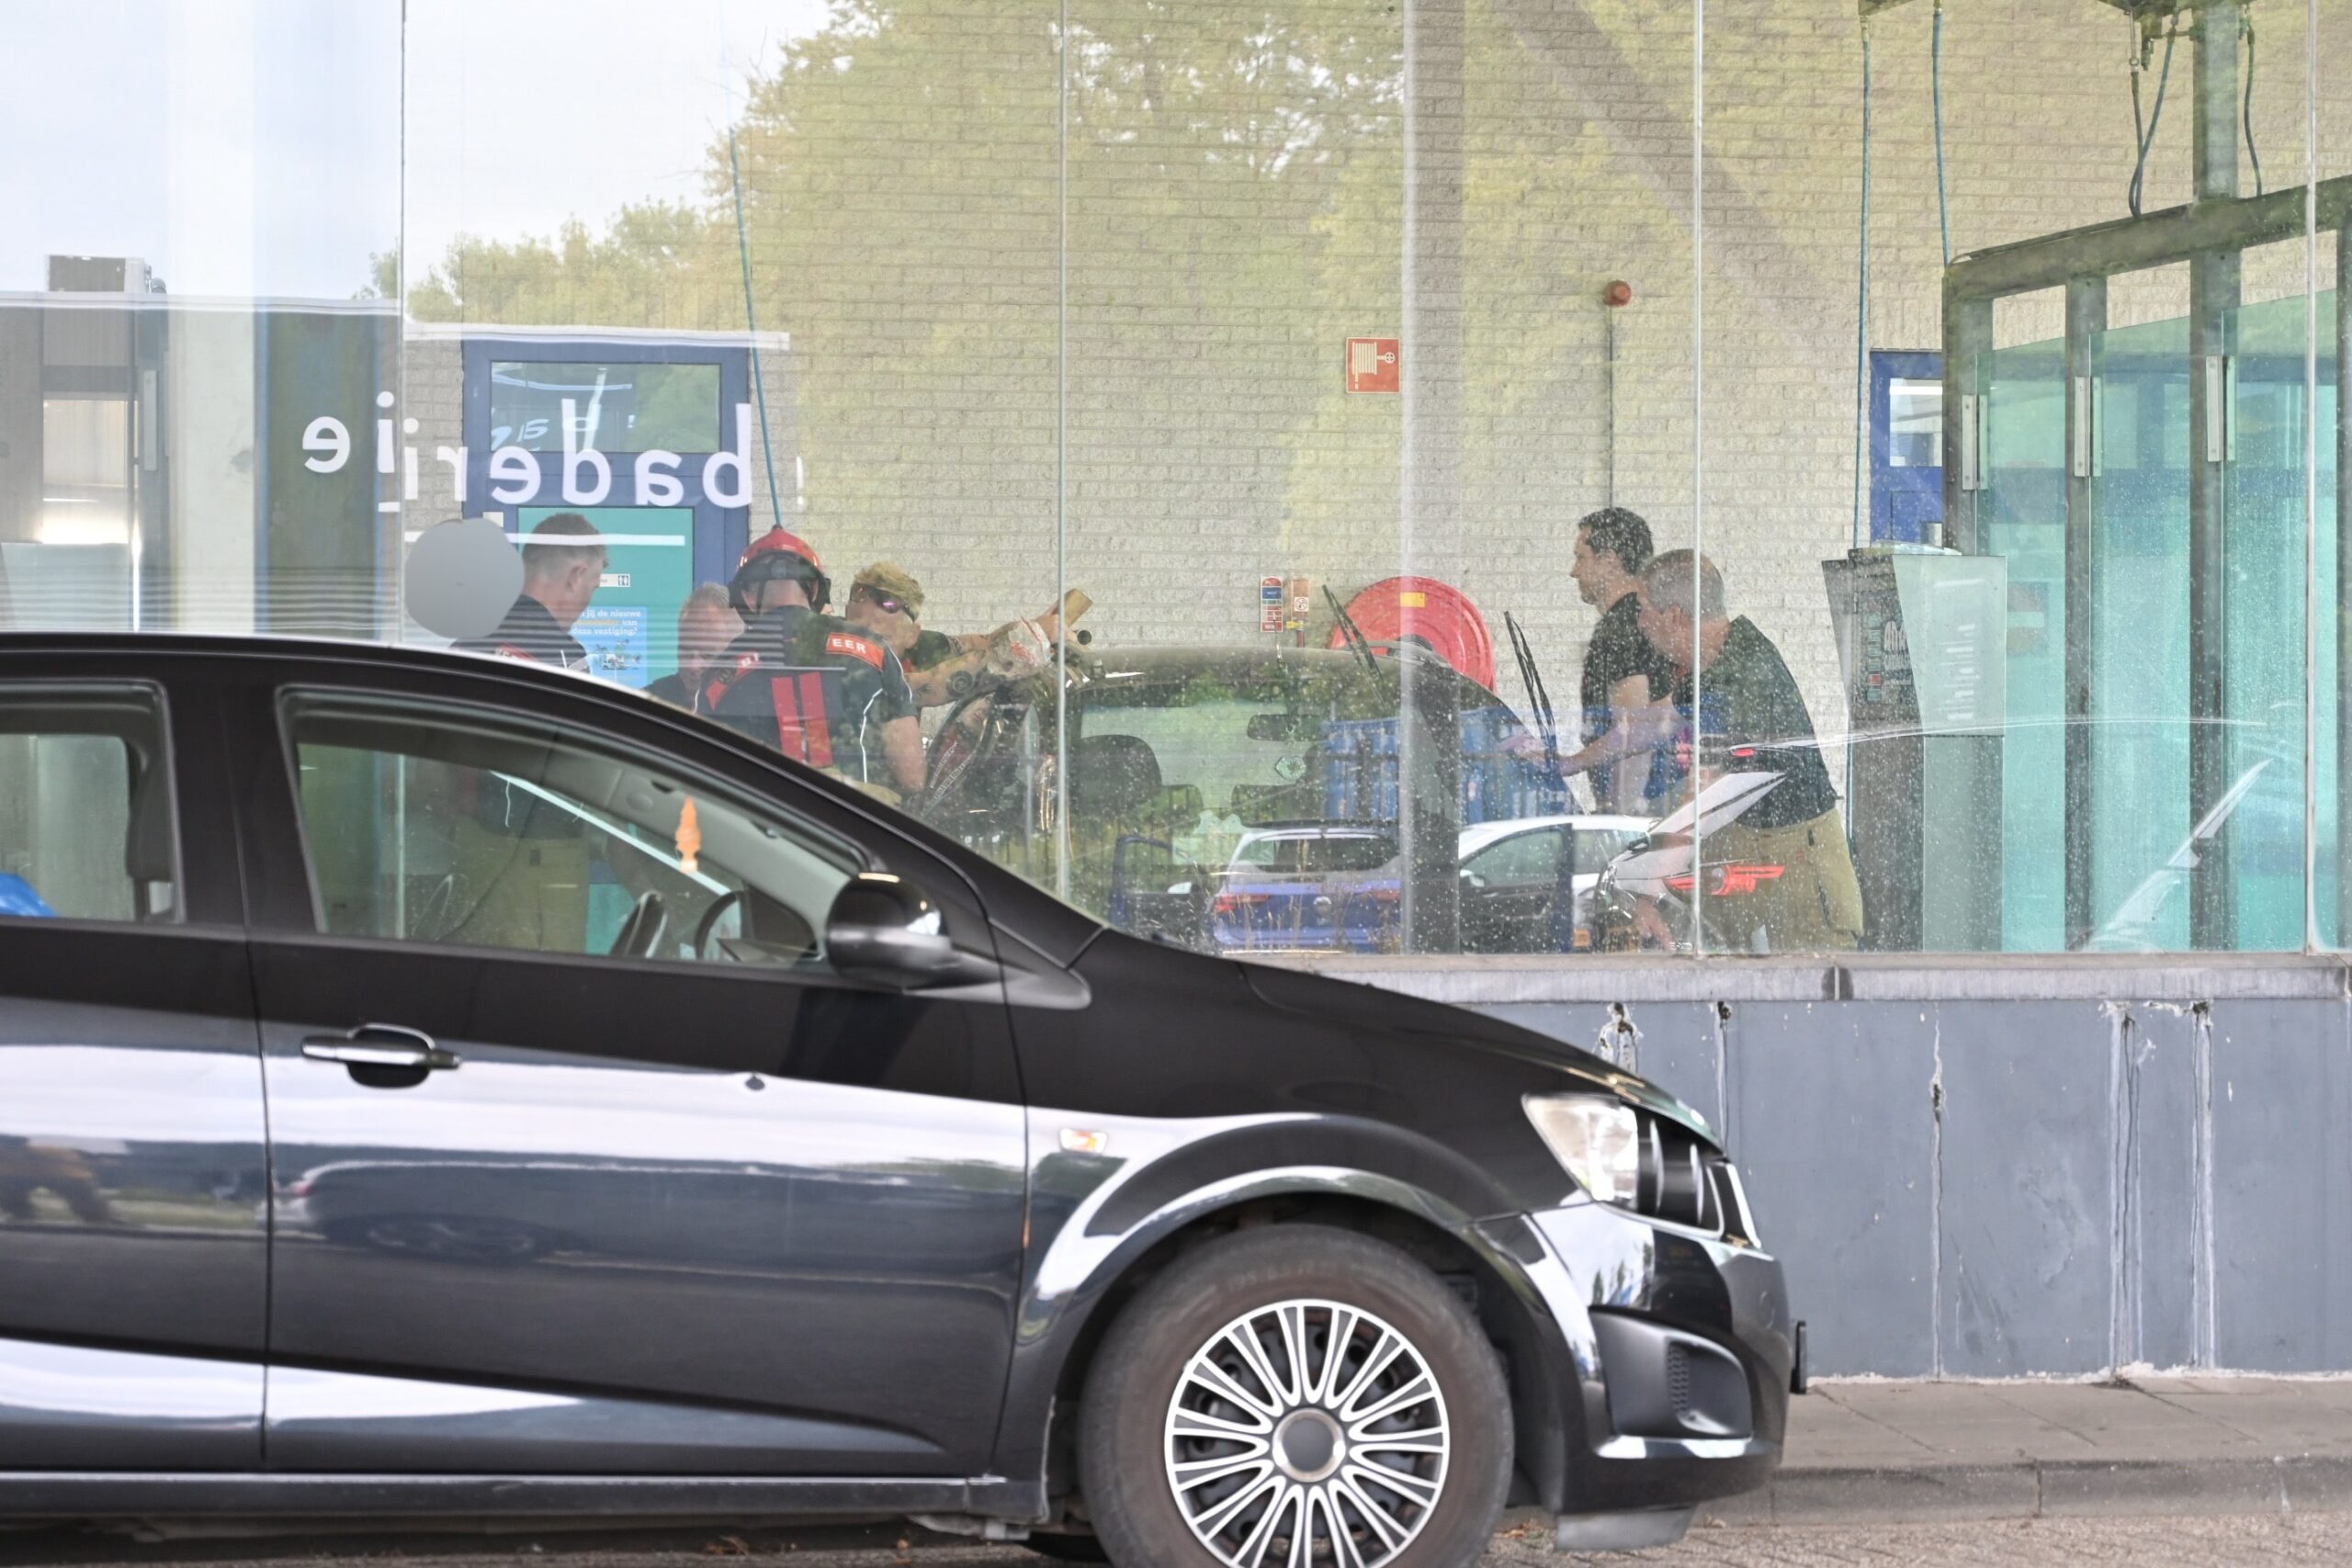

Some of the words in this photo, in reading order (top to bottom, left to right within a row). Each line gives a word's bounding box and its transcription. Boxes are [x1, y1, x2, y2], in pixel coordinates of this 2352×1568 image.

[597, 609, 608, 617] de
[610, 609, 641, 617] nieuwe
[571, 626, 592, 635] deze
[594, 626, 638, 636] vestiging?
